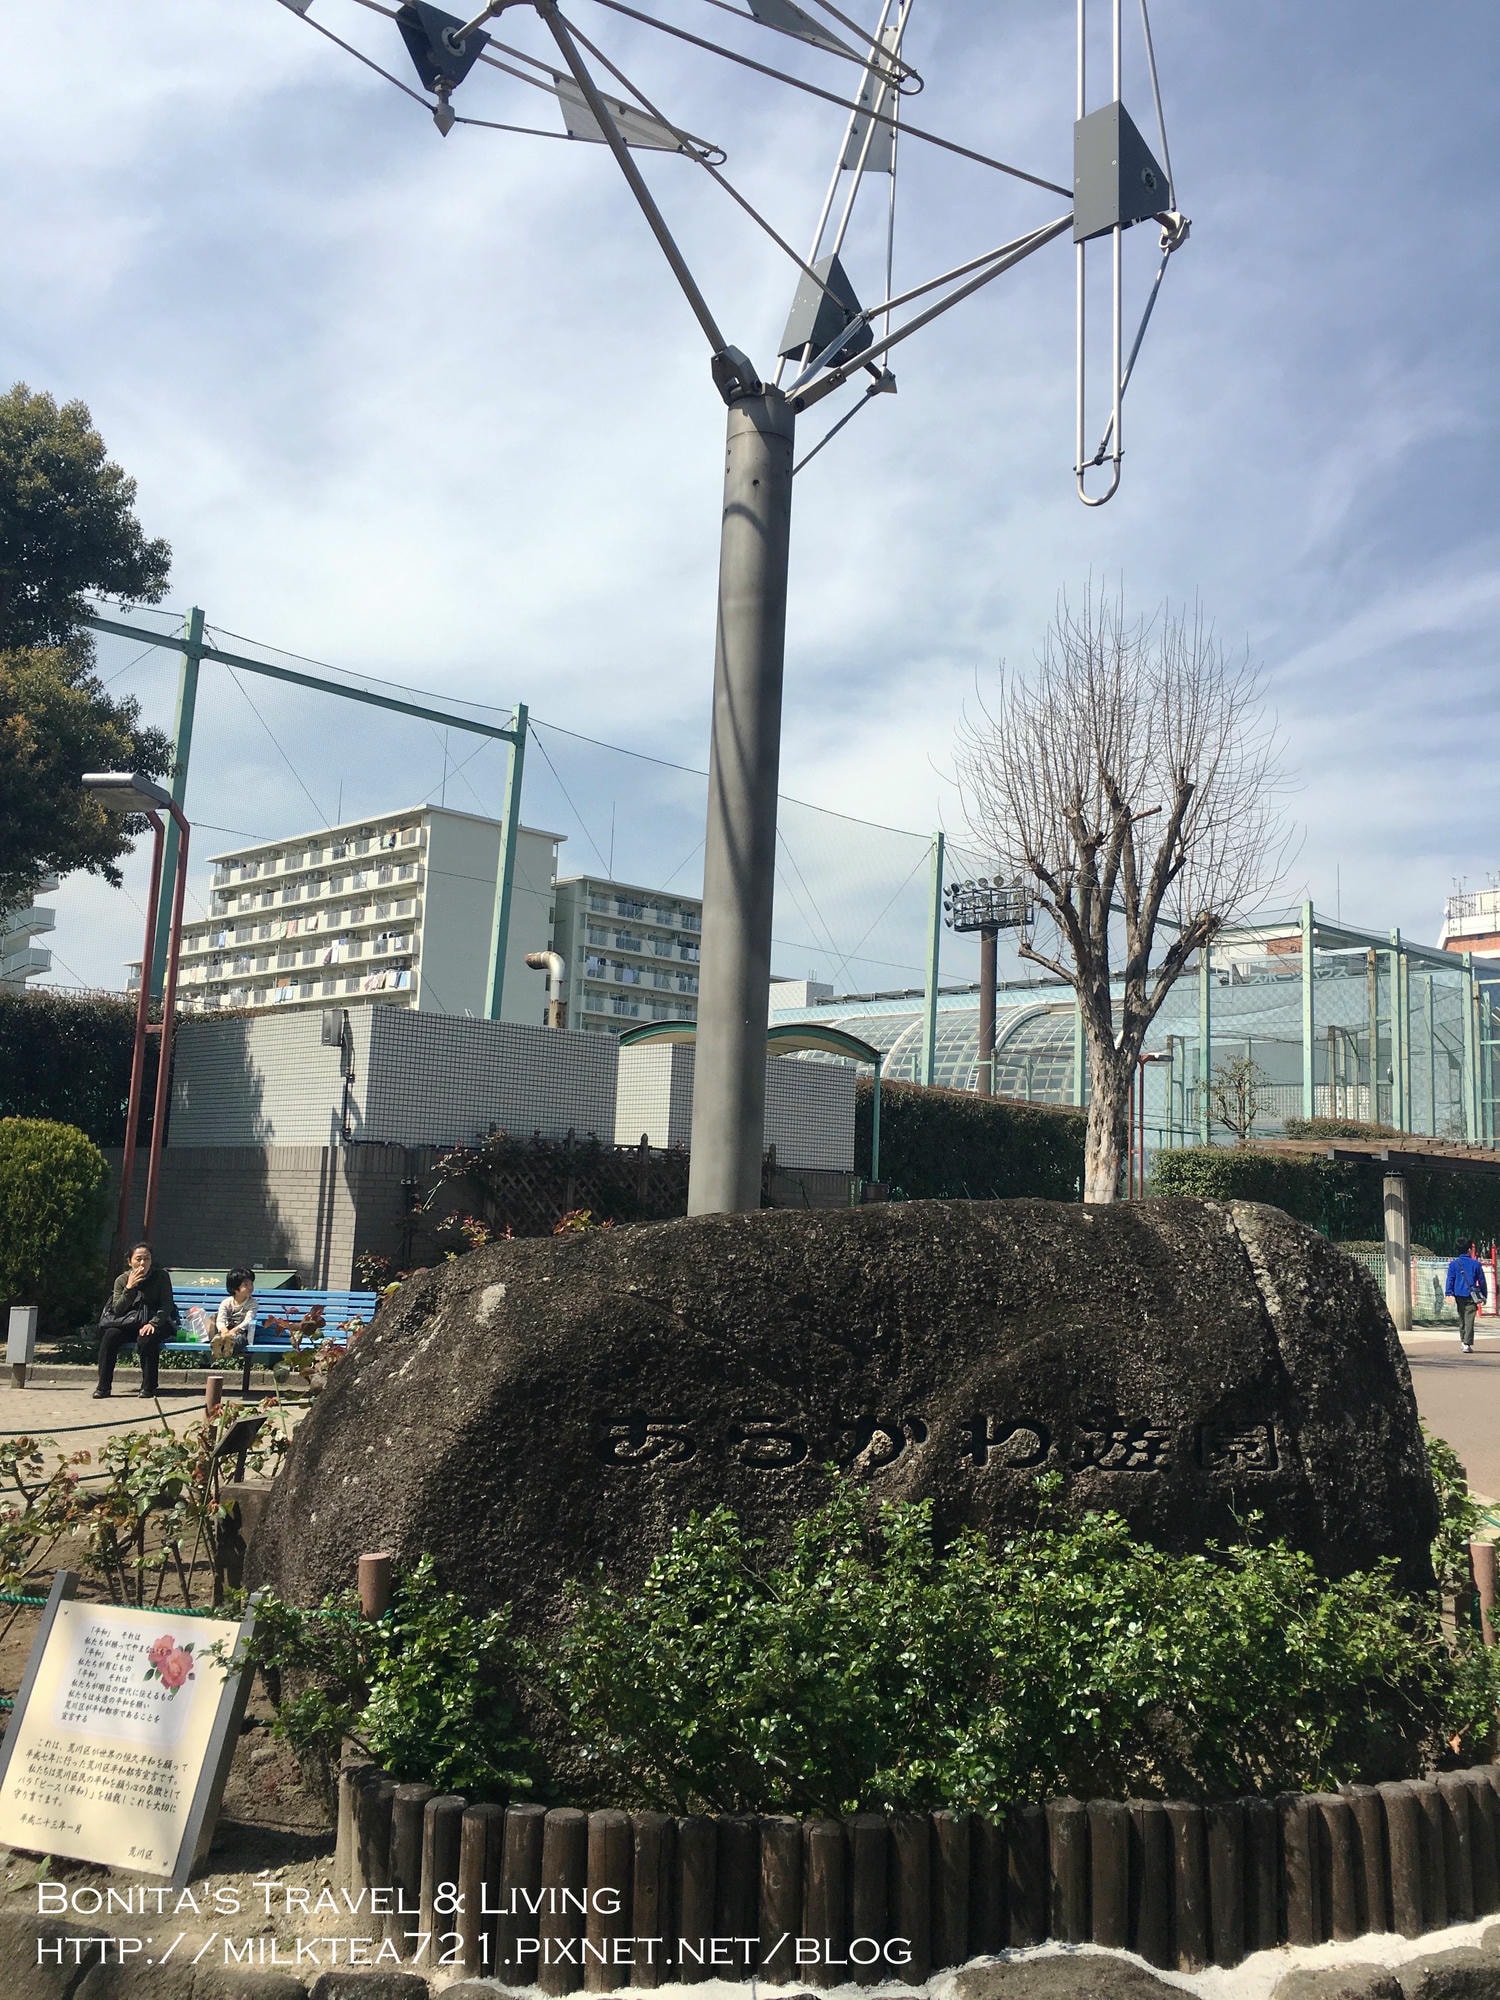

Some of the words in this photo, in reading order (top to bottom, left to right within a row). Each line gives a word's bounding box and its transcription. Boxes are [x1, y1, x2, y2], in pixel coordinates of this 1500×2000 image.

[602, 1414, 1280, 1472] あらかわ遊園
